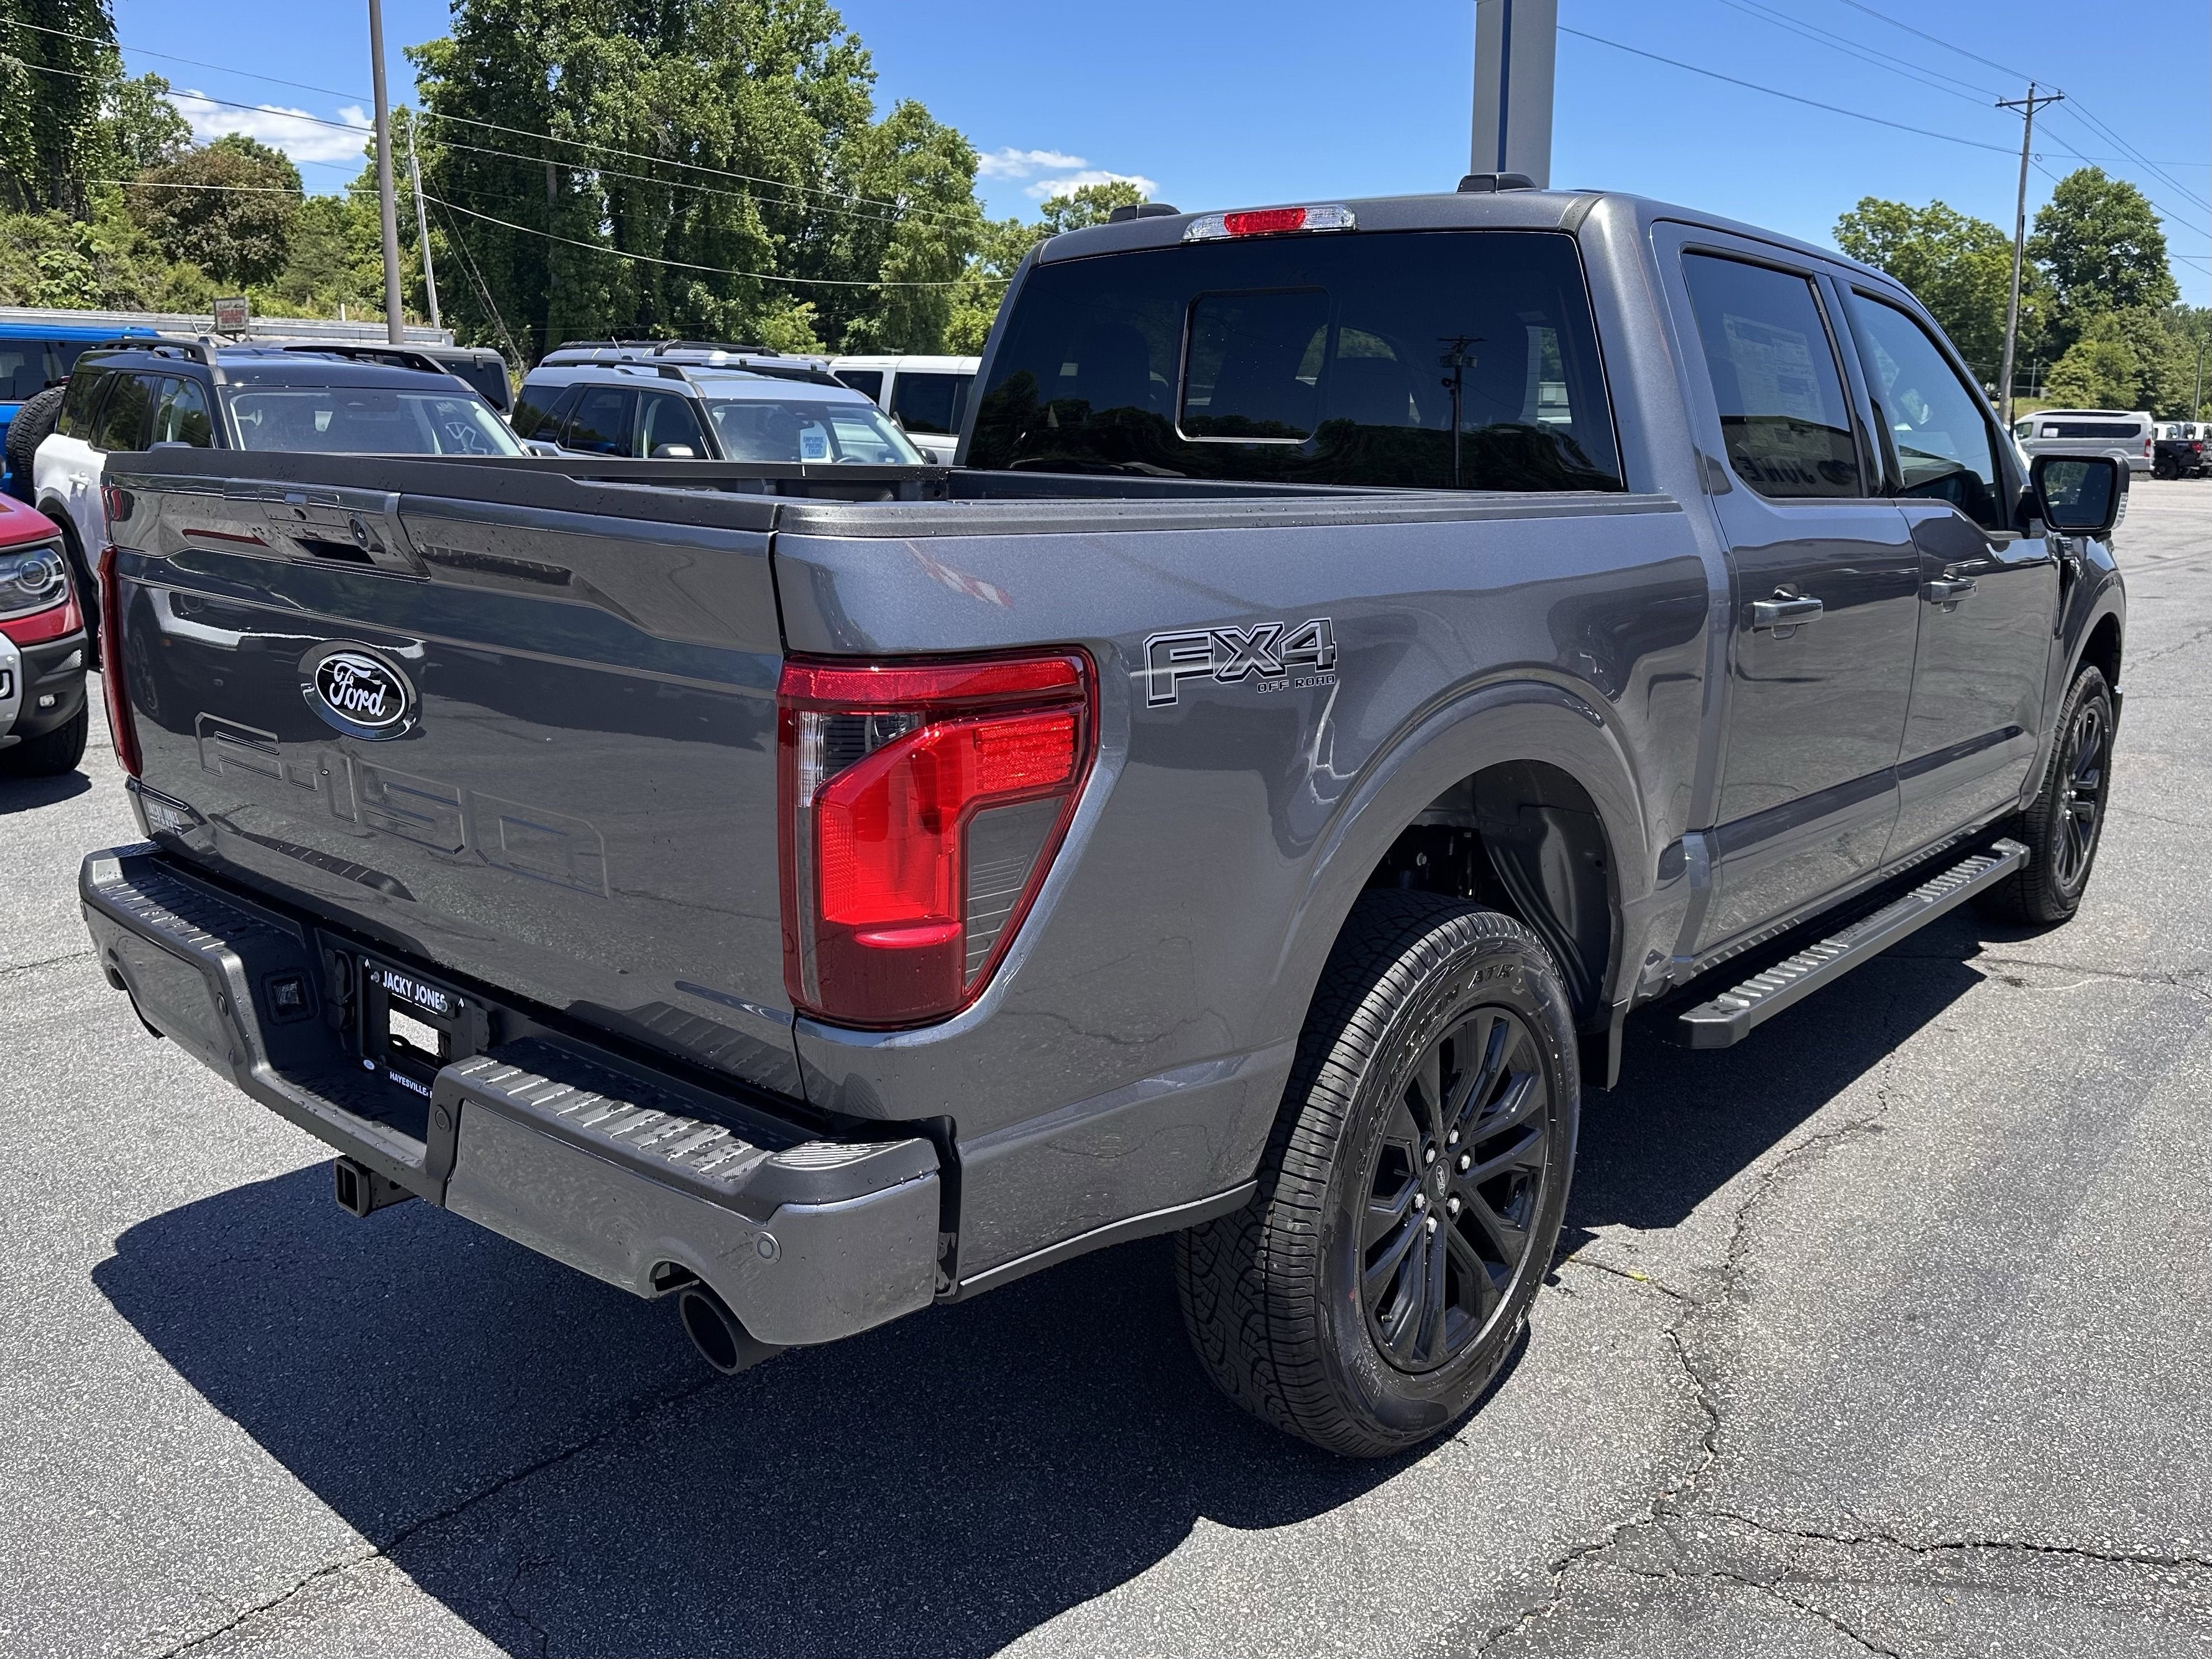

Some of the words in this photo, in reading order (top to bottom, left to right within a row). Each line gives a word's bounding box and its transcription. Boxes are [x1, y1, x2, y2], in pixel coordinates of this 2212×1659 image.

[1143, 617, 1337, 709] FX4
[329, 662, 386, 717] Ford
[1257, 679, 1290, 694] OFF
[1295, 674, 1336, 689] ROAD
[147, 801, 163, 818] JACKY
[162, 807, 180, 825] JONES
[195, 712, 609, 900] F-150
[383, 970, 413, 997] JACKY
[415, 983, 447, 1010] JONES
[1467, 963, 1514, 990] ATR
[390, 1071, 429, 1097] HAYESVILLE,
